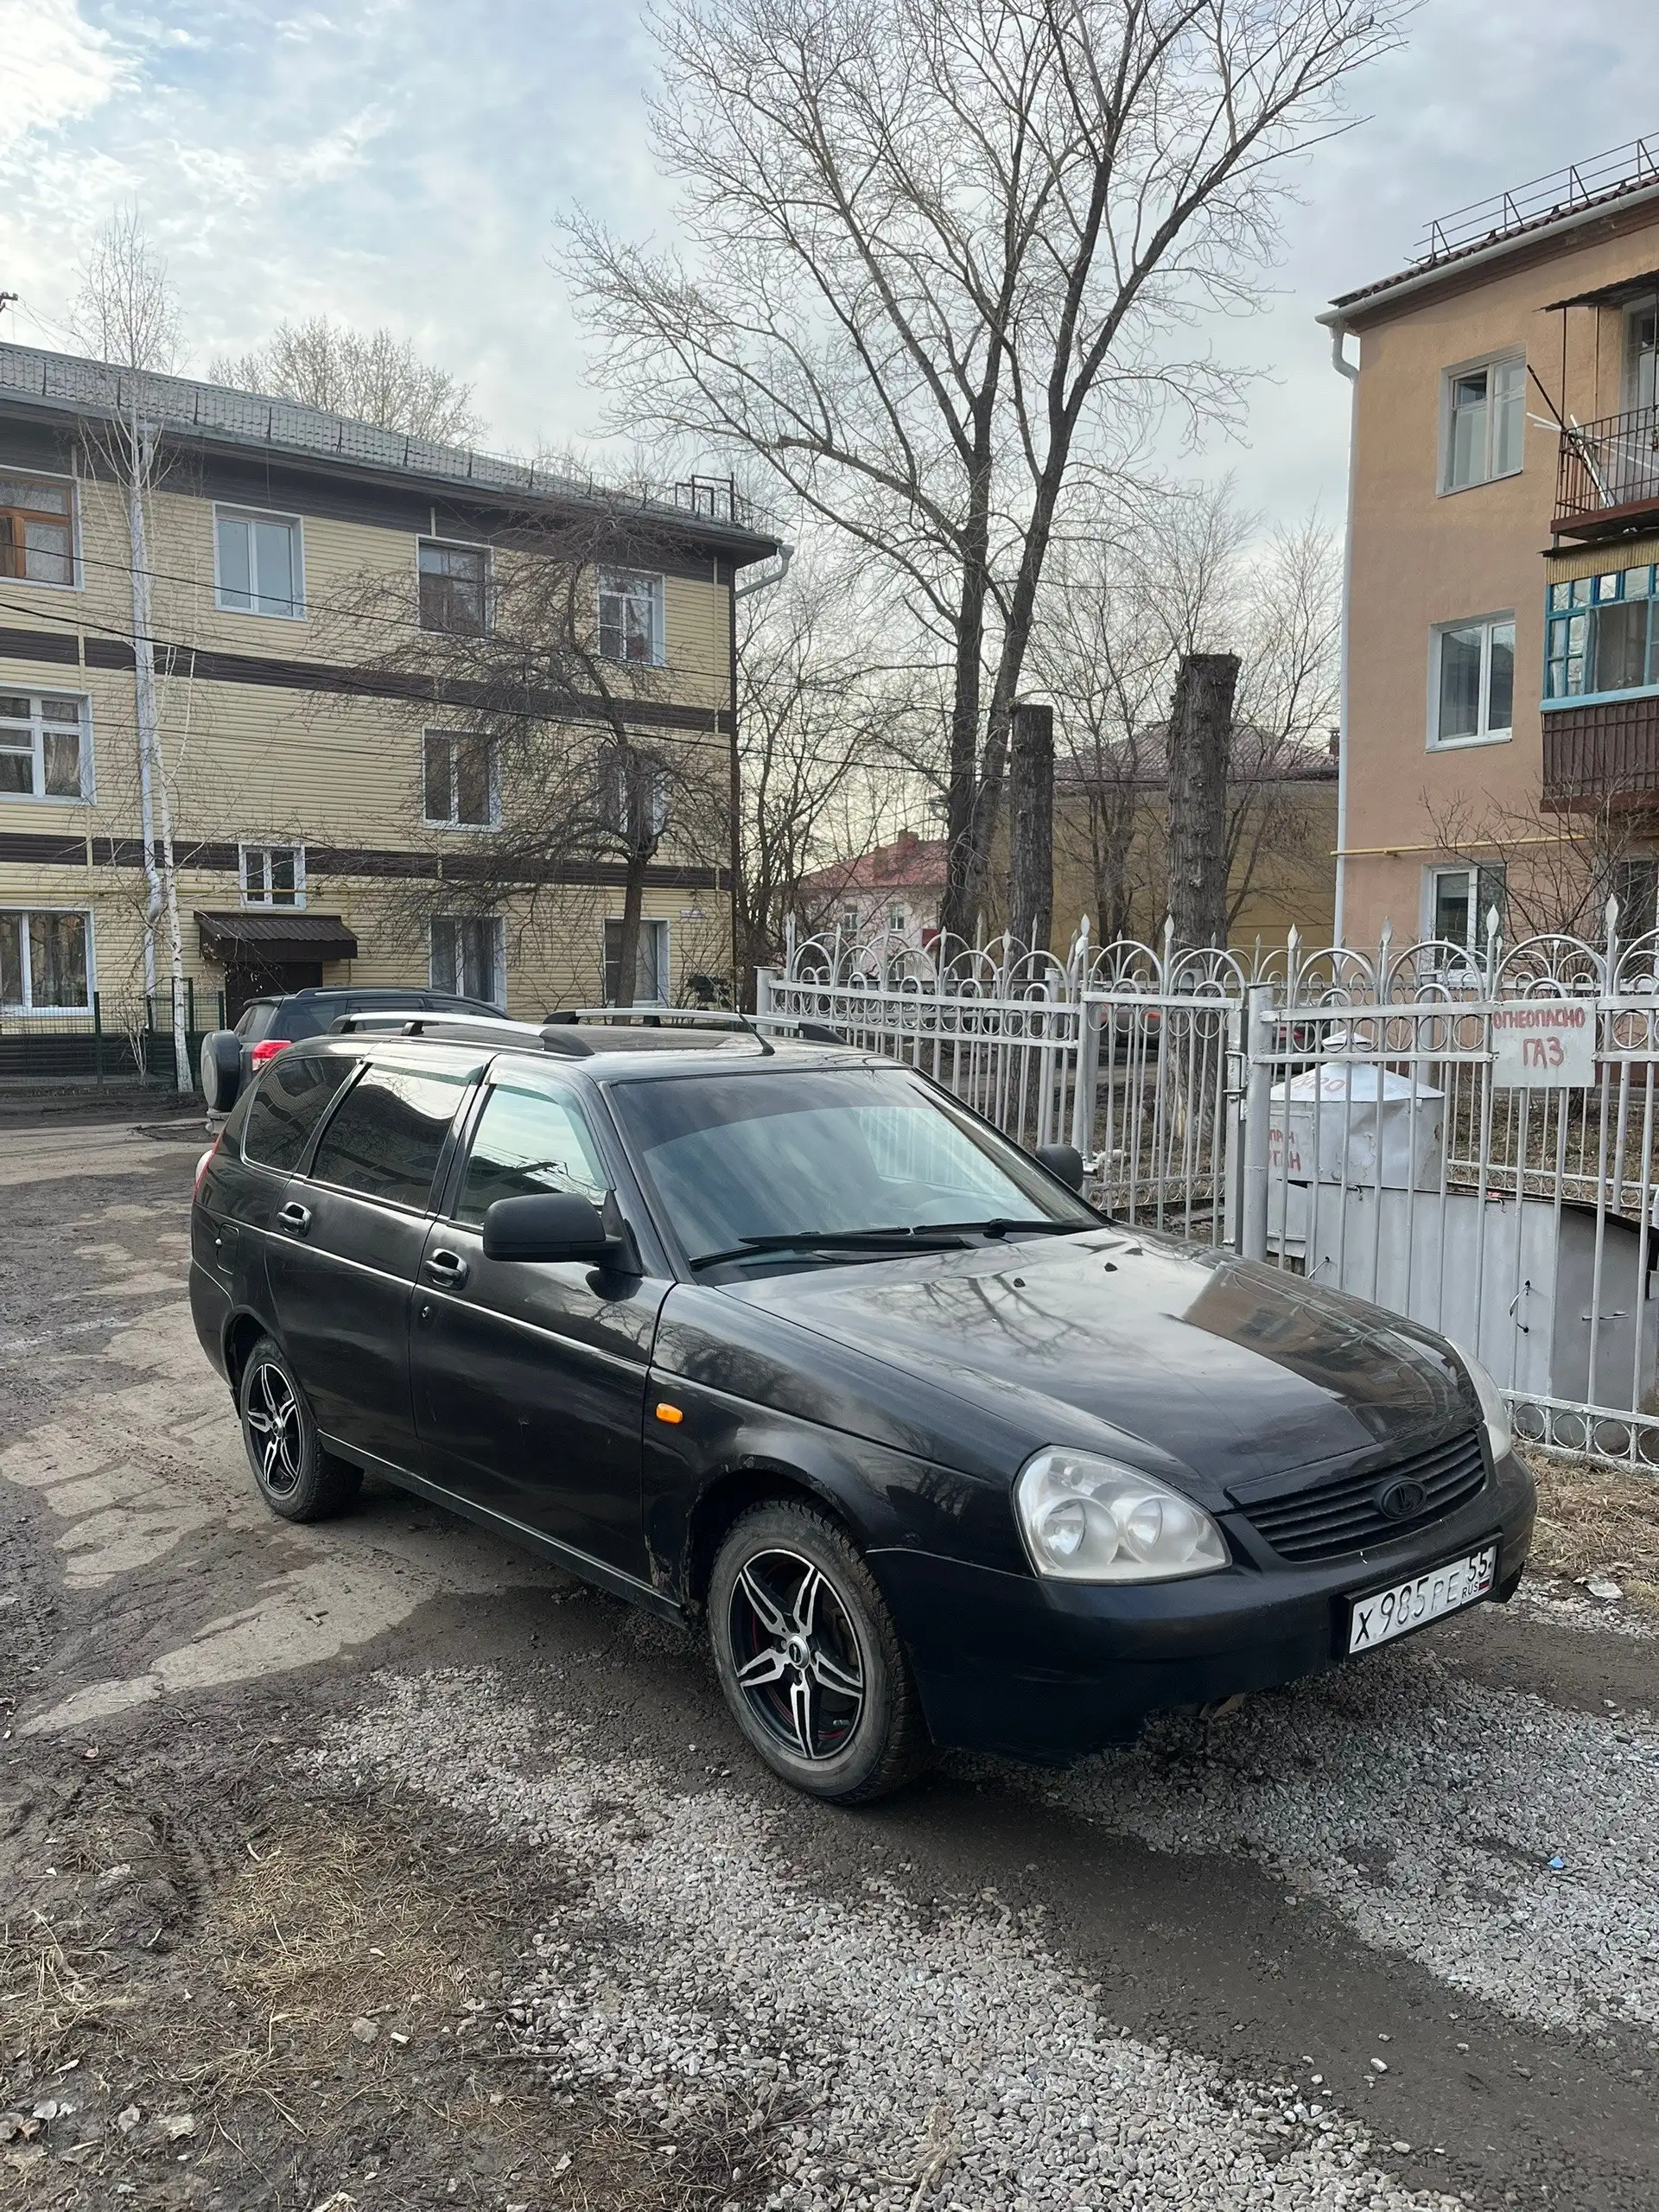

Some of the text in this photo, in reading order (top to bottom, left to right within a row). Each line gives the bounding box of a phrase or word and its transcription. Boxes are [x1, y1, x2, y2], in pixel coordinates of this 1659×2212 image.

[1492, 1006, 1586, 1030] ОГНЕОПАСНО
[1522, 1036, 1565, 1069] ГАЗ
[1461, 1581, 1478, 1599] RUS
